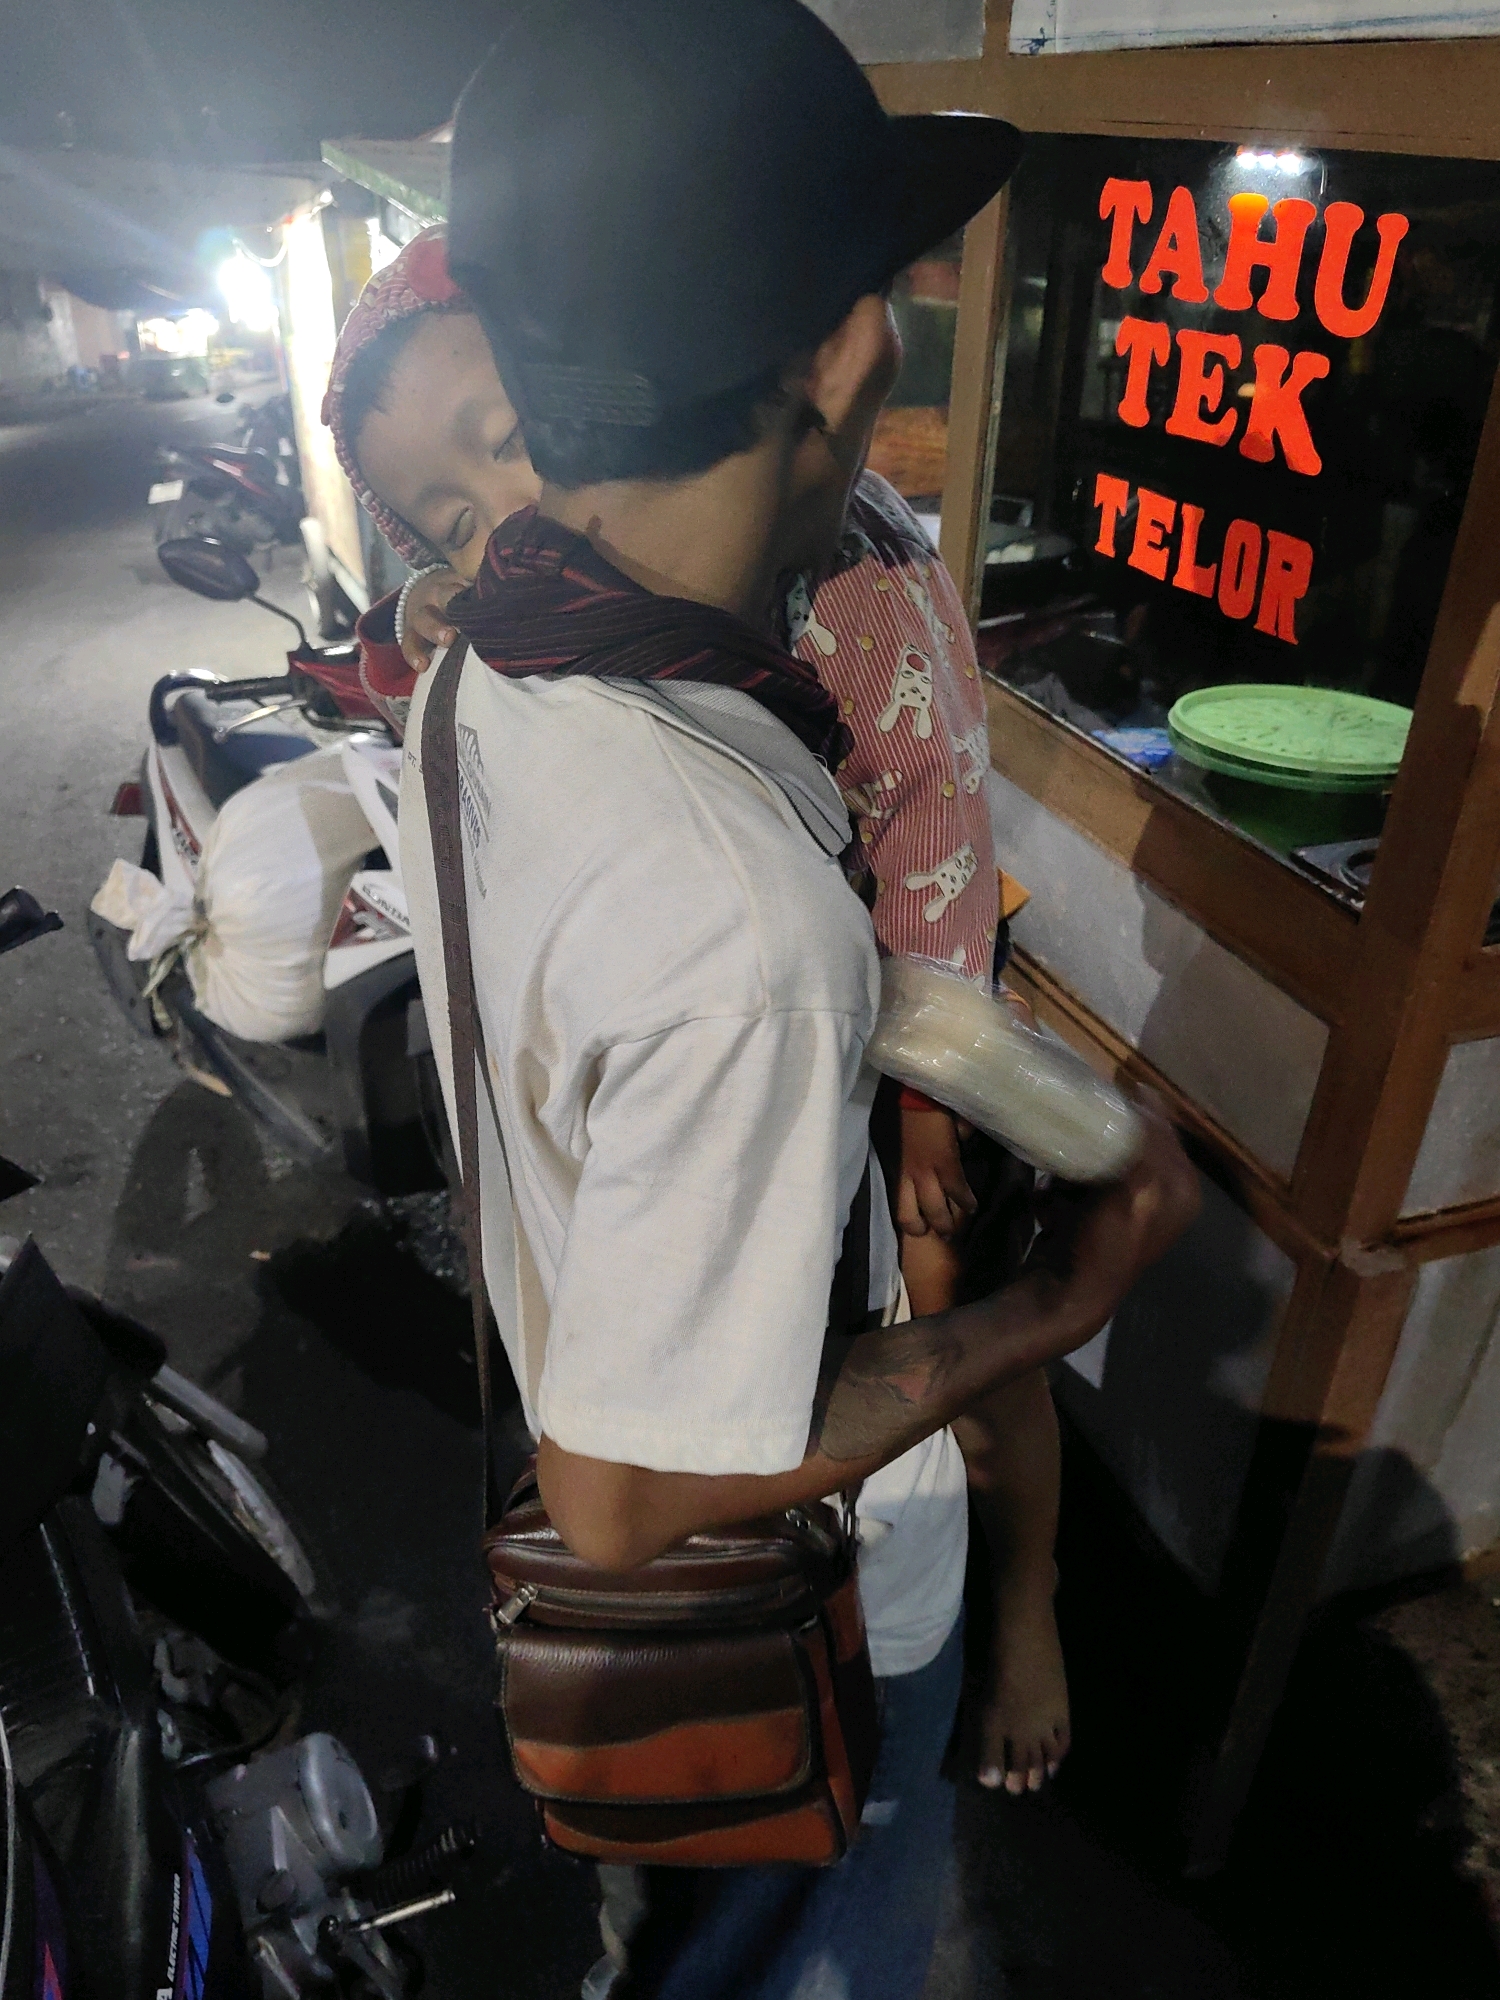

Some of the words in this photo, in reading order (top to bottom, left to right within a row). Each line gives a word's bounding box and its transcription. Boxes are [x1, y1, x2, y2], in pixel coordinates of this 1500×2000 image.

[1099, 177, 1409, 338] TAHU
[1116, 315, 1330, 476] TEK
[1094, 473, 1313, 645] TELOR
